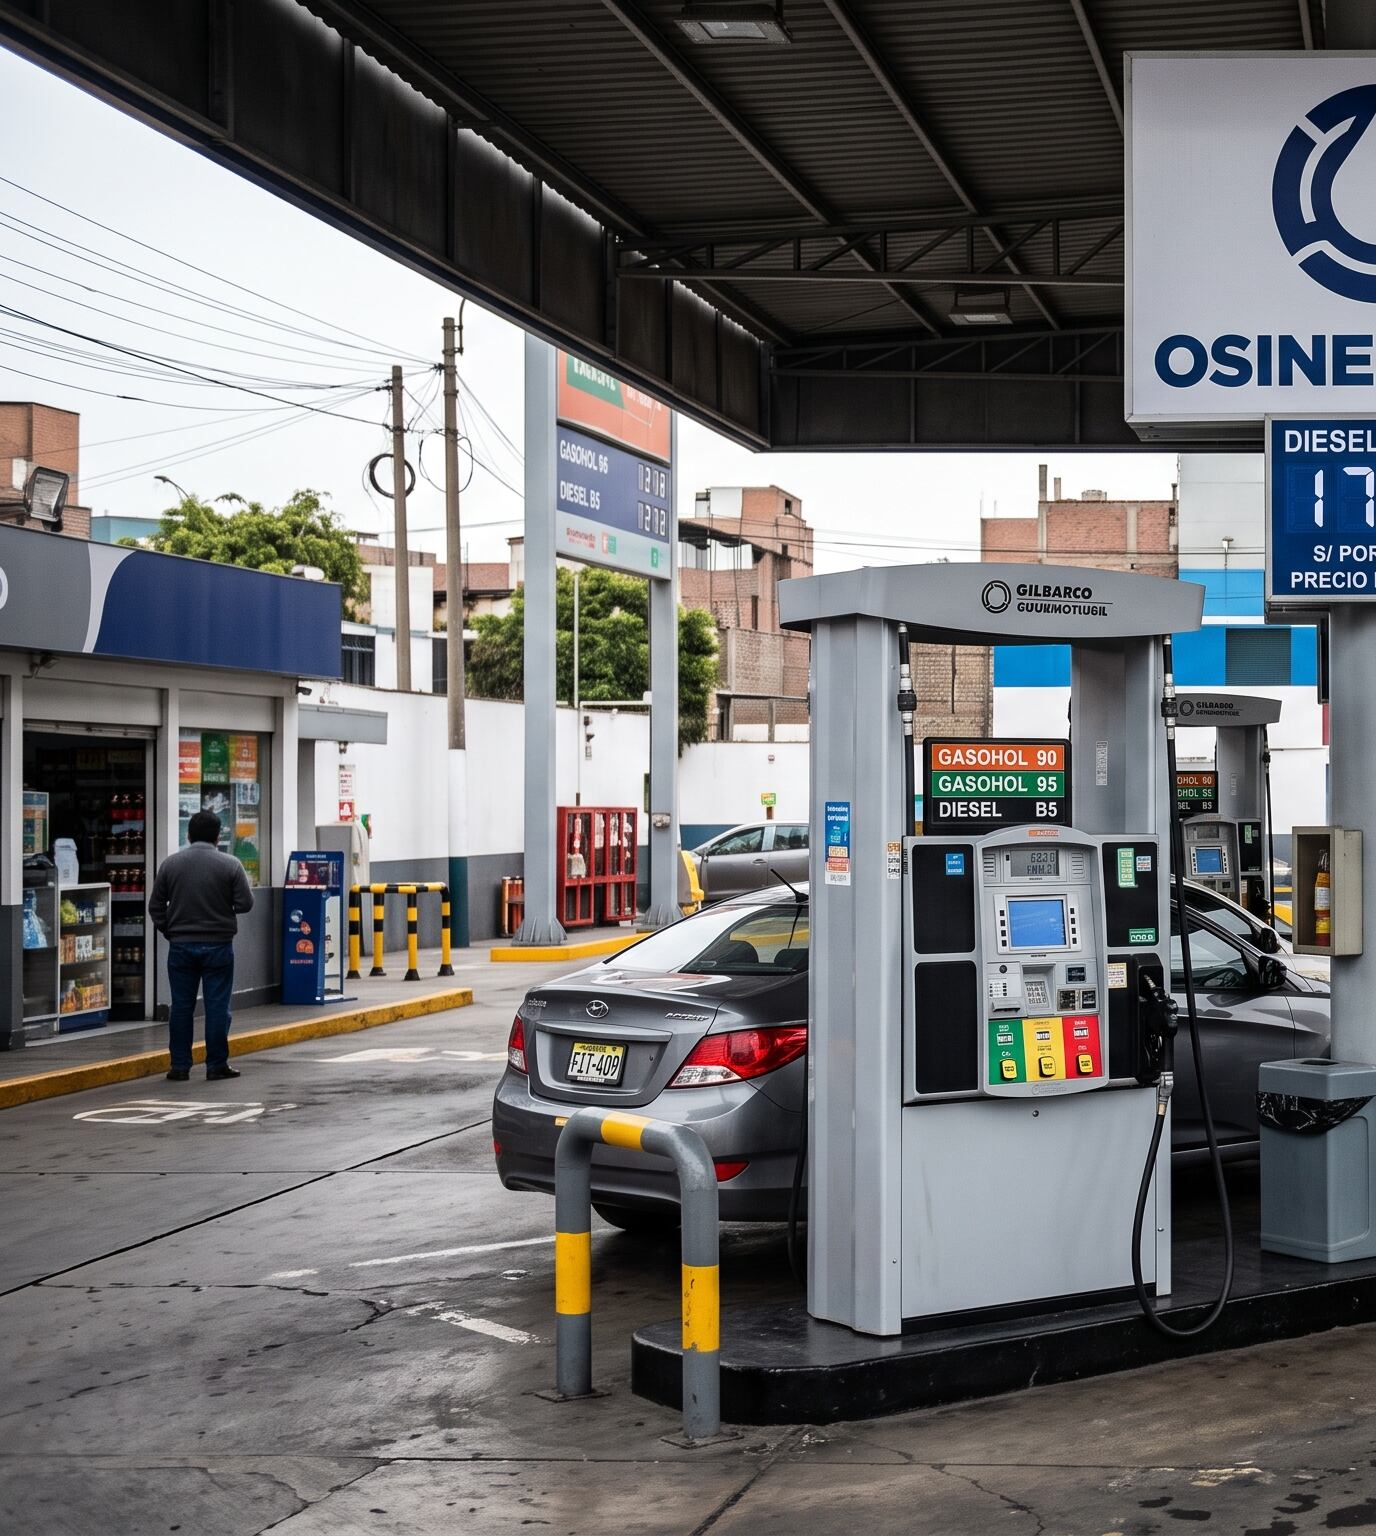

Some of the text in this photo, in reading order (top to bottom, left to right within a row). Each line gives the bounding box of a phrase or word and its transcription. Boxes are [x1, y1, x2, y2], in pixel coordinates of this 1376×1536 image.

[560, 440, 598, 471] GASOHOL
[560, 480, 600, 511] DIESEL B5
[1313, 544, 1333, 562] S/
[1291, 571, 1367, 589] PRECIO
[1016, 583, 1093, 600] GILBARCO
[938, 748, 1057, 766] GASOHOL 90
[938, 775, 1057, 792] GASOHOL 95
[939, 801, 1058, 818] DIESEL B5
[570, 1052, 620, 1077] FIT-409
